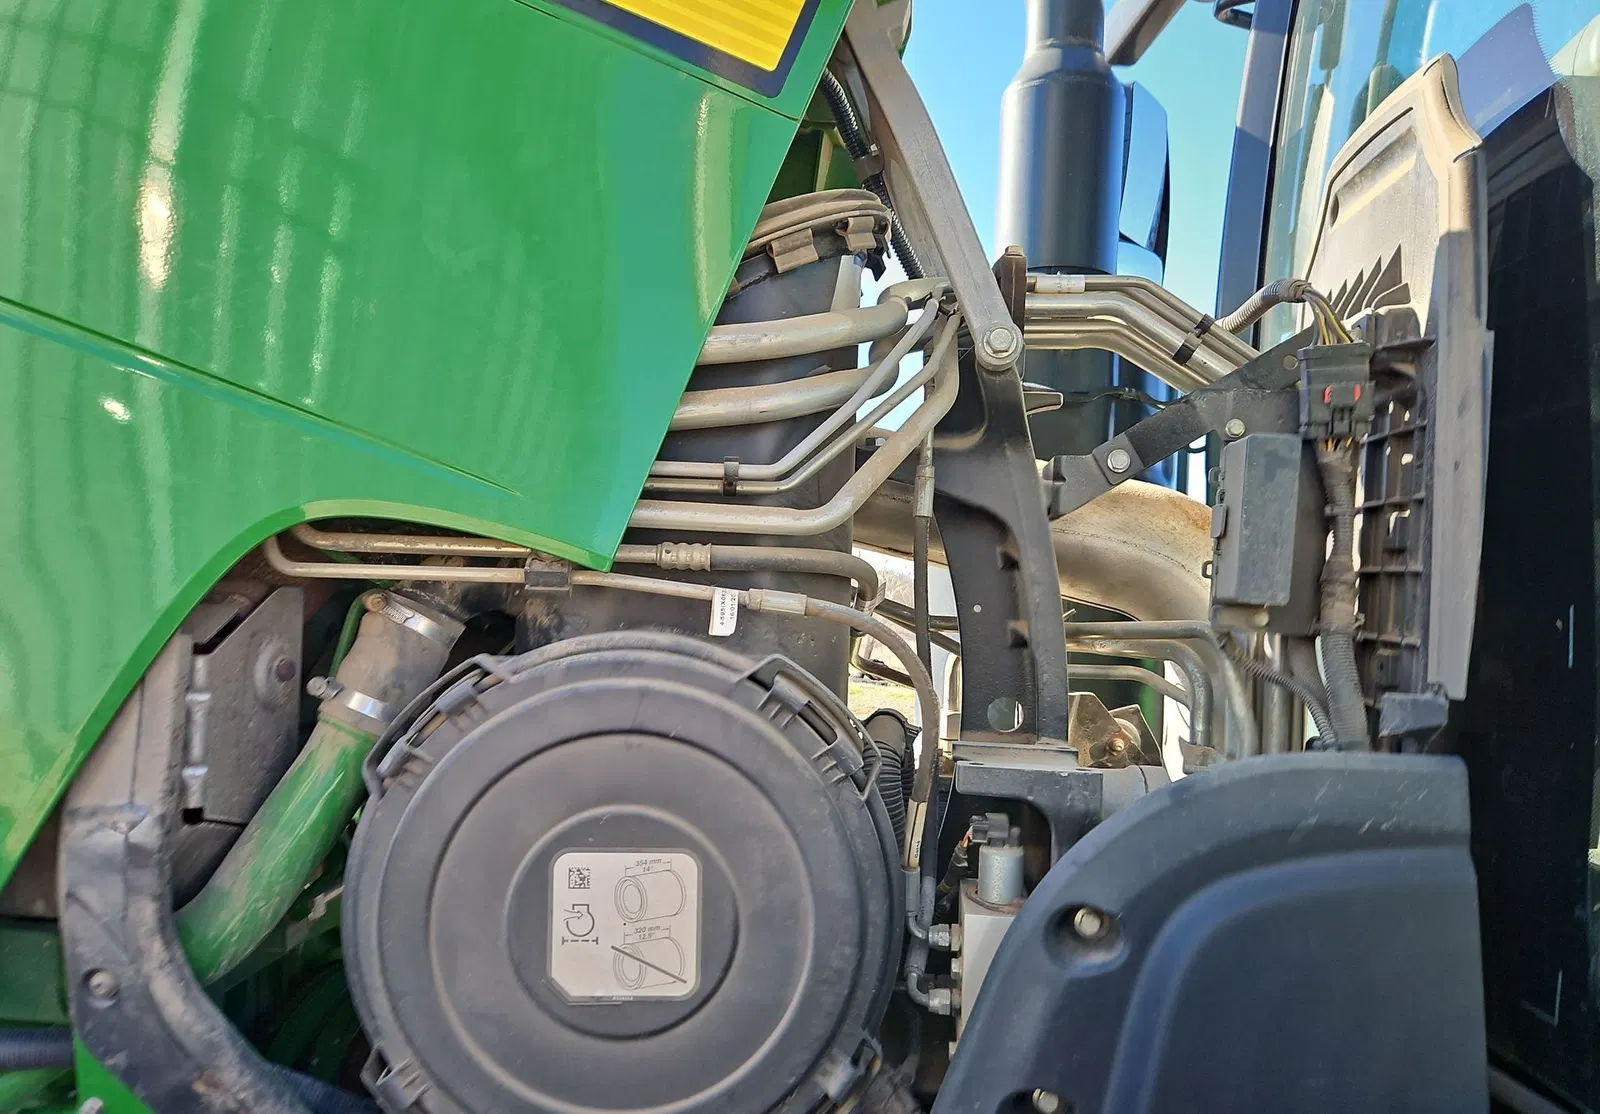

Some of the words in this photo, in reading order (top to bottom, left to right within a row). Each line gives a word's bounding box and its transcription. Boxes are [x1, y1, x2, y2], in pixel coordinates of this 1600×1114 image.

[635, 859, 648, 867] 354
[634, 926, 647, 934] 320
[638, 932, 655, 940] 12.5"
